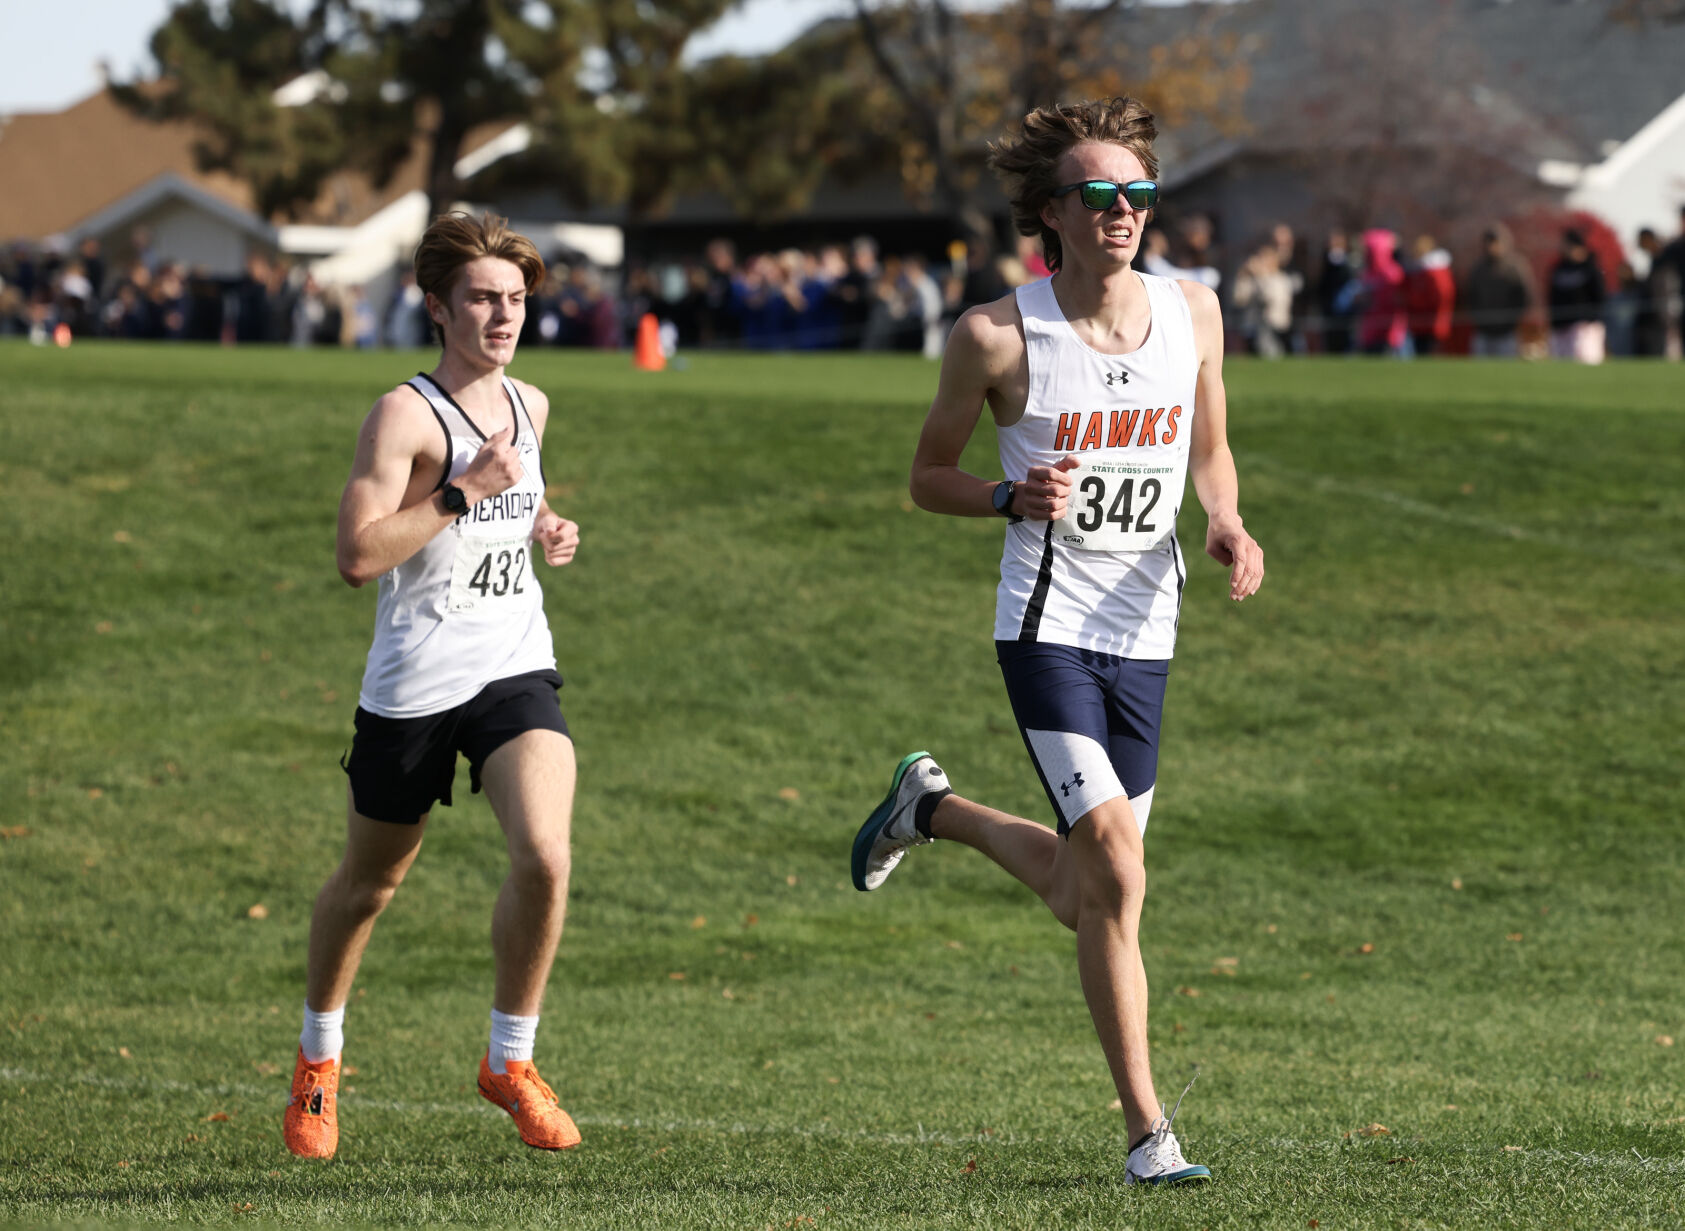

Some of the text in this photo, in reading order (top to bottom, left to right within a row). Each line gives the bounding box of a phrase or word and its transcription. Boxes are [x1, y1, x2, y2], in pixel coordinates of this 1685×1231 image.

[1054, 405, 1182, 451] HAWKS
[1091, 465, 1116, 474] STATE
[1117, 466, 1142, 475] CROSS
[1076, 475, 1162, 533] 342
[468, 547, 526, 598] 432
